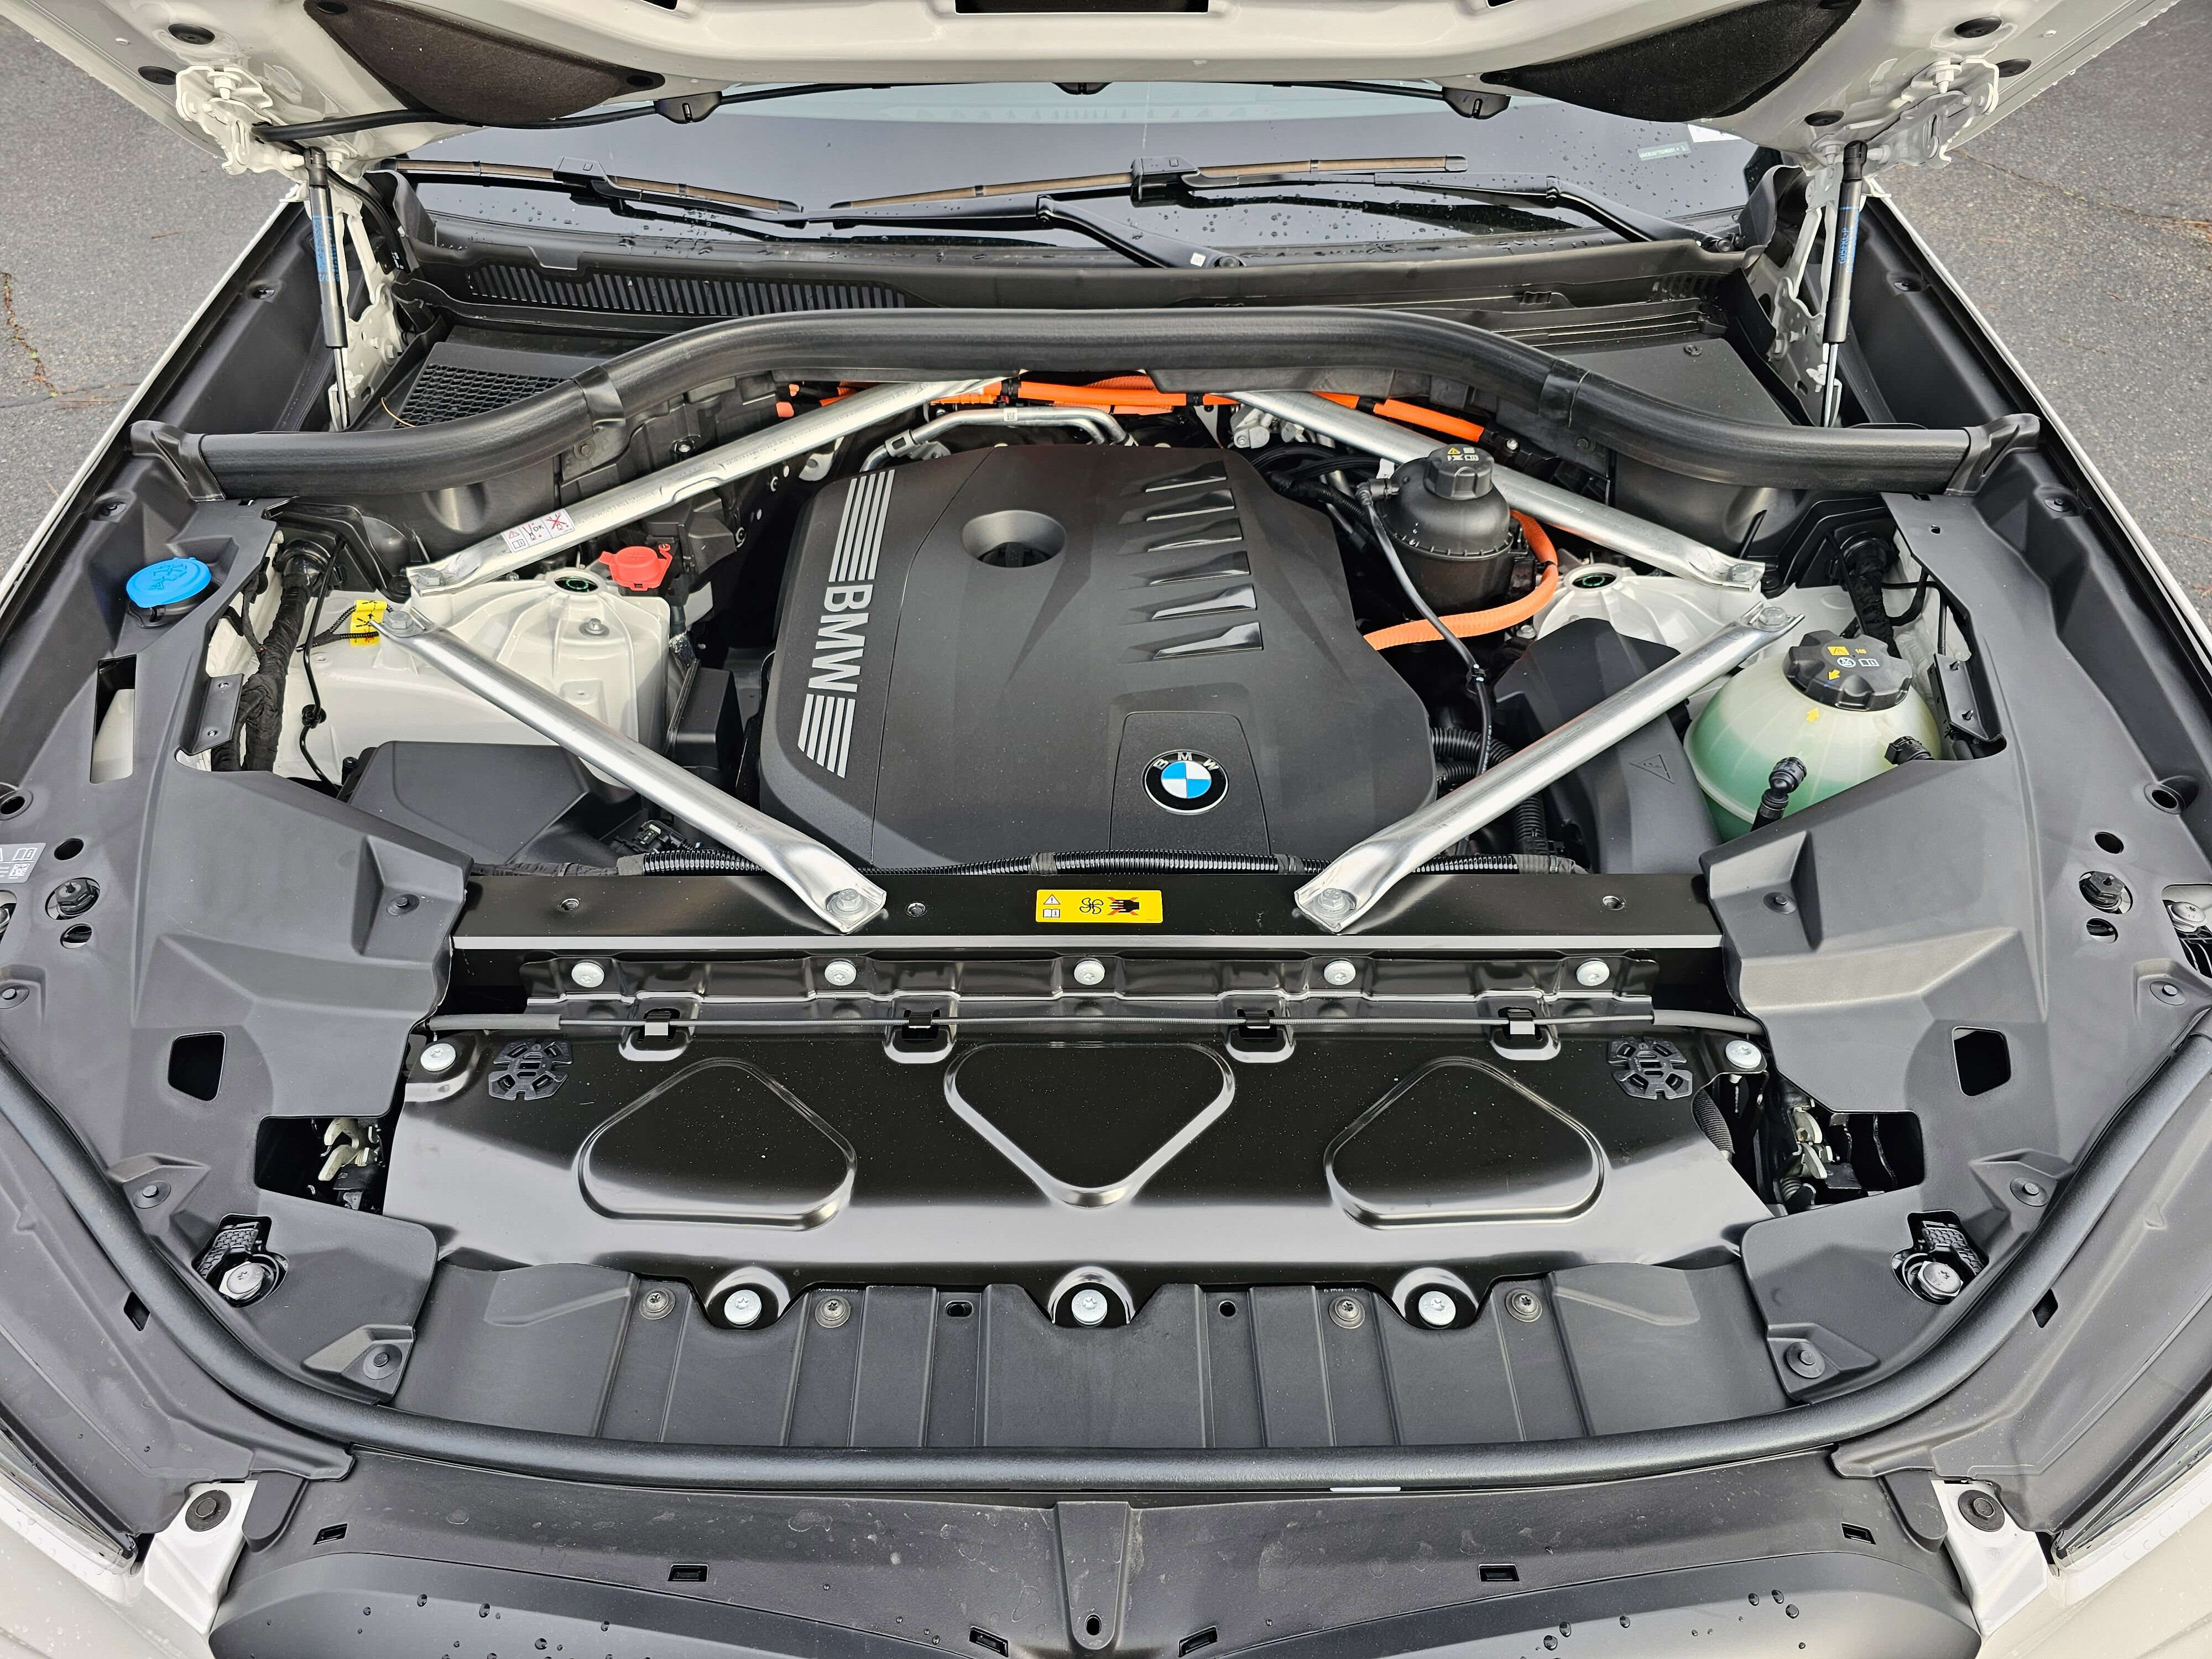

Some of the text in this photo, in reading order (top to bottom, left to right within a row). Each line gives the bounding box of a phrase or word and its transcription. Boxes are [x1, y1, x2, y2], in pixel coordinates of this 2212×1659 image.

[533, 524, 545, 532] OK
[808, 585, 874, 692] BMW
[1152, 752, 1219, 771] BMW
